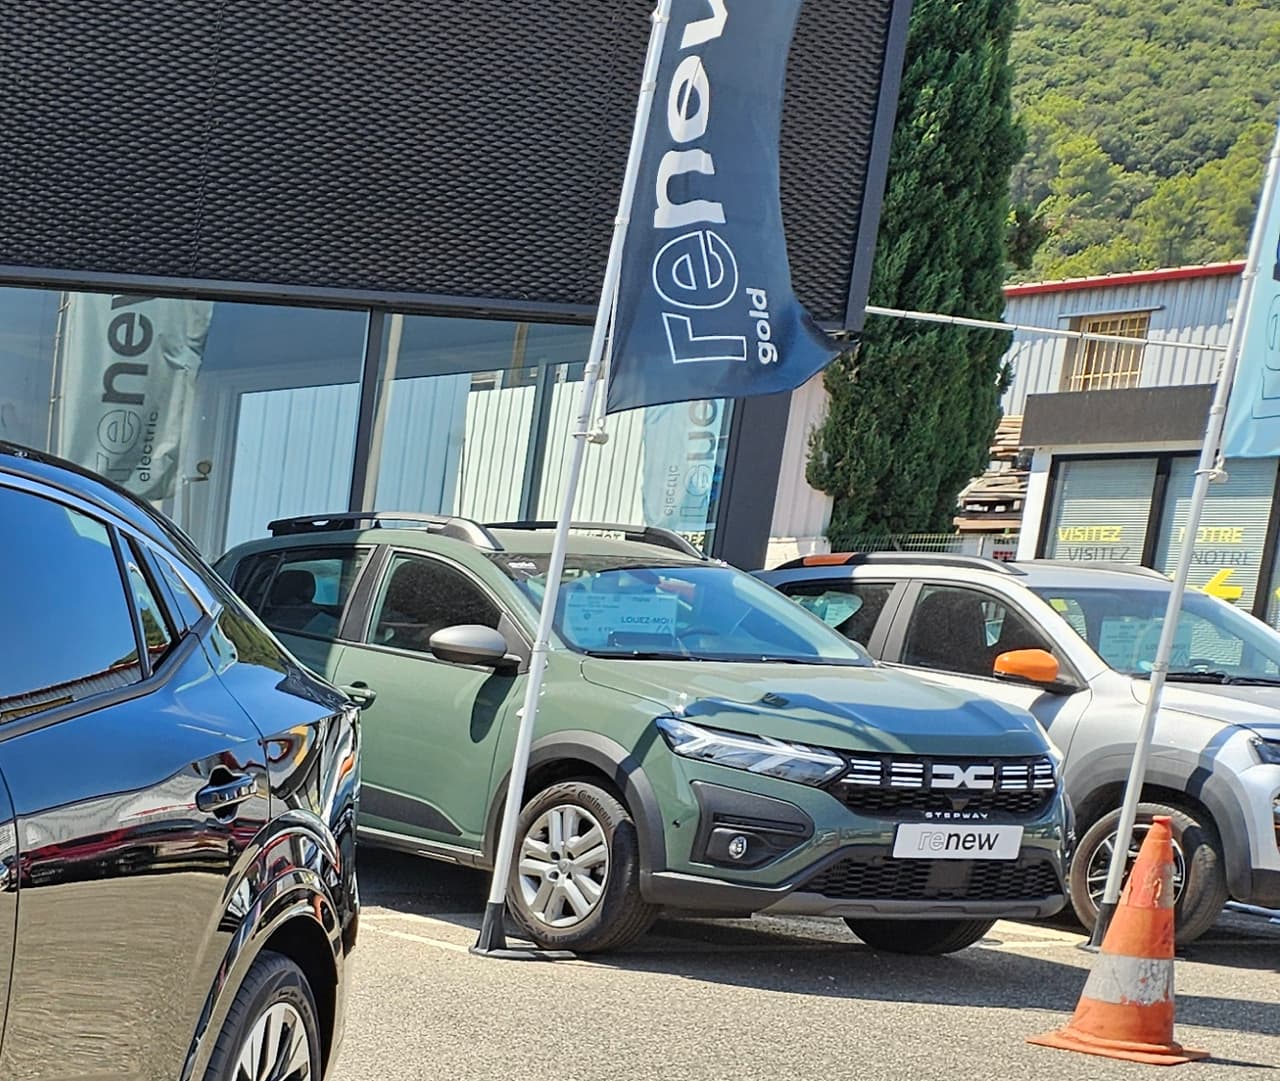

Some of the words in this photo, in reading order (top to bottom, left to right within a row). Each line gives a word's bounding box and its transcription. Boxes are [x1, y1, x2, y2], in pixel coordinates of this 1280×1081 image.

[746, 287, 778, 364] gold
[137, 411, 160, 483] electric
[1057, 526, 1123, 542] VISITEZ
[925, 811, 988, 819] STEPWAY
[918, 831, 999, 850] renew
